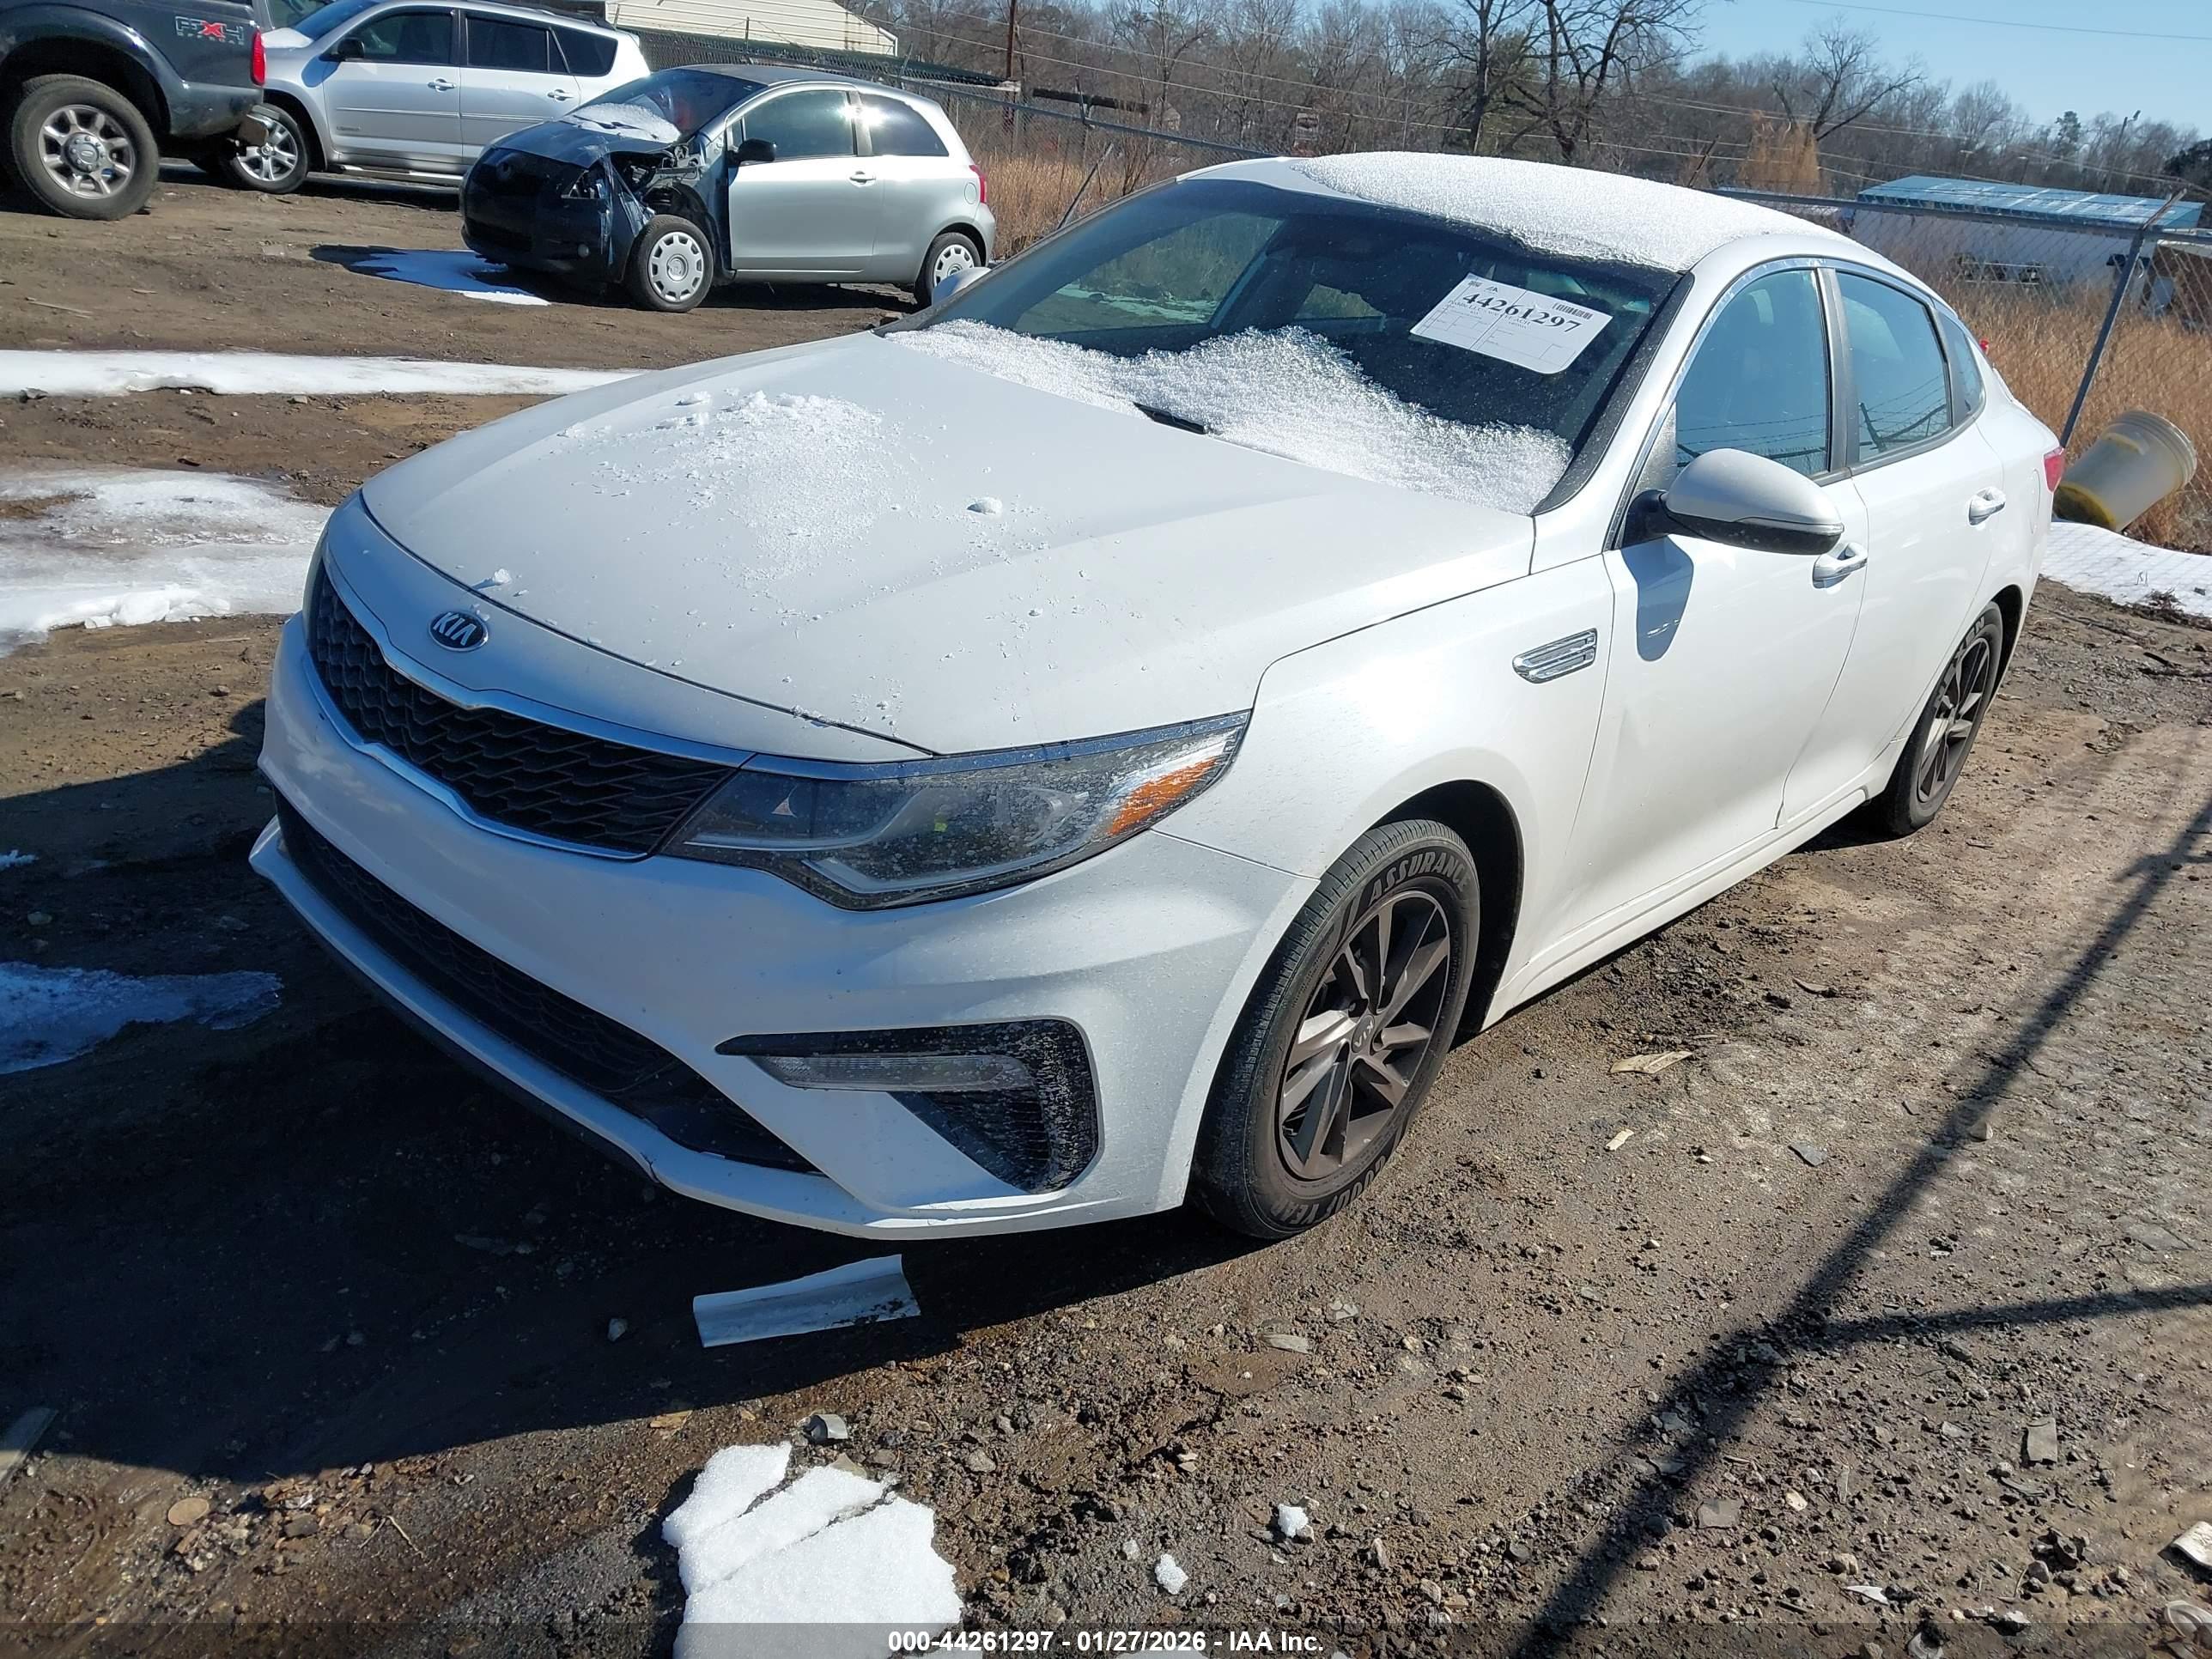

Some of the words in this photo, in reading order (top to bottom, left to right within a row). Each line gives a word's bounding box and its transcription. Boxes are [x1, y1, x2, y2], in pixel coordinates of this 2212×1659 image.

[174, 15, 244, 41] FX4
[1462, 293, 1583, 332] 44261297
[432, 611, 477, 647] KIA
[1369, 851, 1469, 906] ASSURANCE
[1354, 1019, 1374, 1048] KIA
